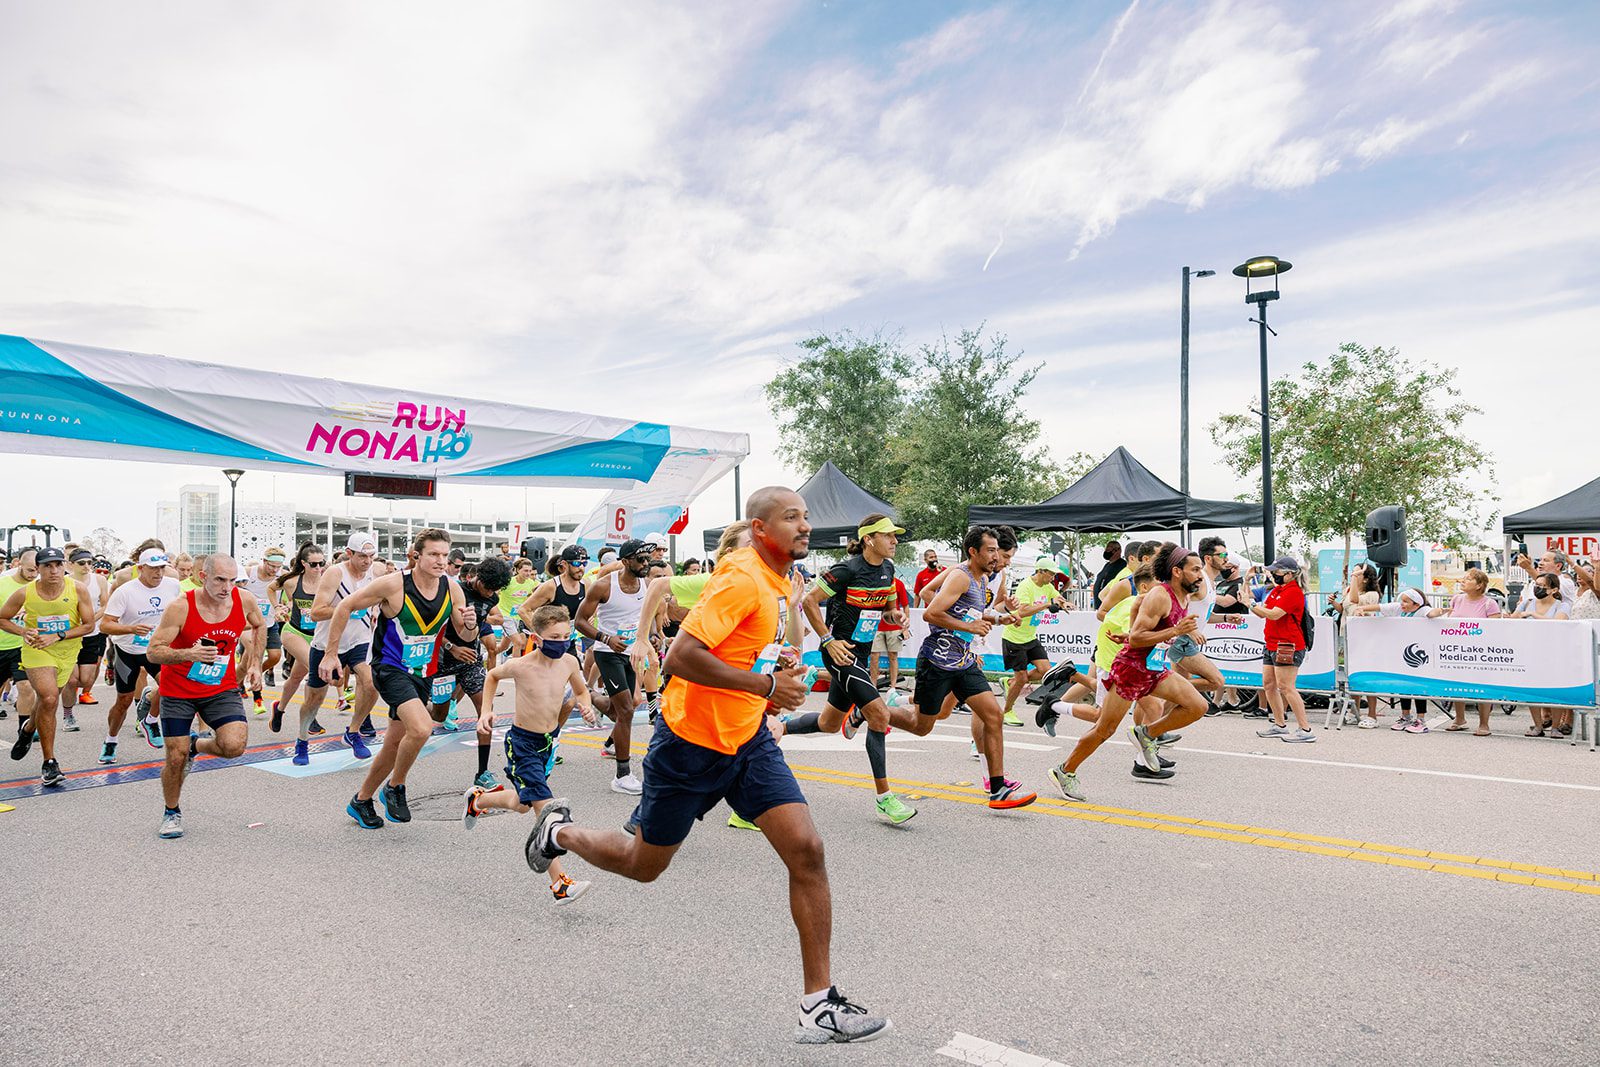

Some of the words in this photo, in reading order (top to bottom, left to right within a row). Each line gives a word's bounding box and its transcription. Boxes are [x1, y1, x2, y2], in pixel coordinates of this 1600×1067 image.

[392, 401, 466, 433] RUN
[614, 507, 626, 532] 6
[514, 525, 521, 544] 7
[42, 621, 66, 633] 536
[1036, 633, 1091, 645] EMOURS
[409, 643, 430, 659] 261
[1045, 645, 1066, 654] DREN'S
[1067, 646, 1091, 655] HEALTH
[1231, 642, 1265, 656] Shac
[1439, 644, 1459, 652] UCF
[1461, 645, 1484, 653] Lake
[1488, 646, 1514, 654] Nona
[1440, 653, 1477, 661] Medical
[1480, 655, 1514, 663] Center
[432, 683, 453, 697] 809
